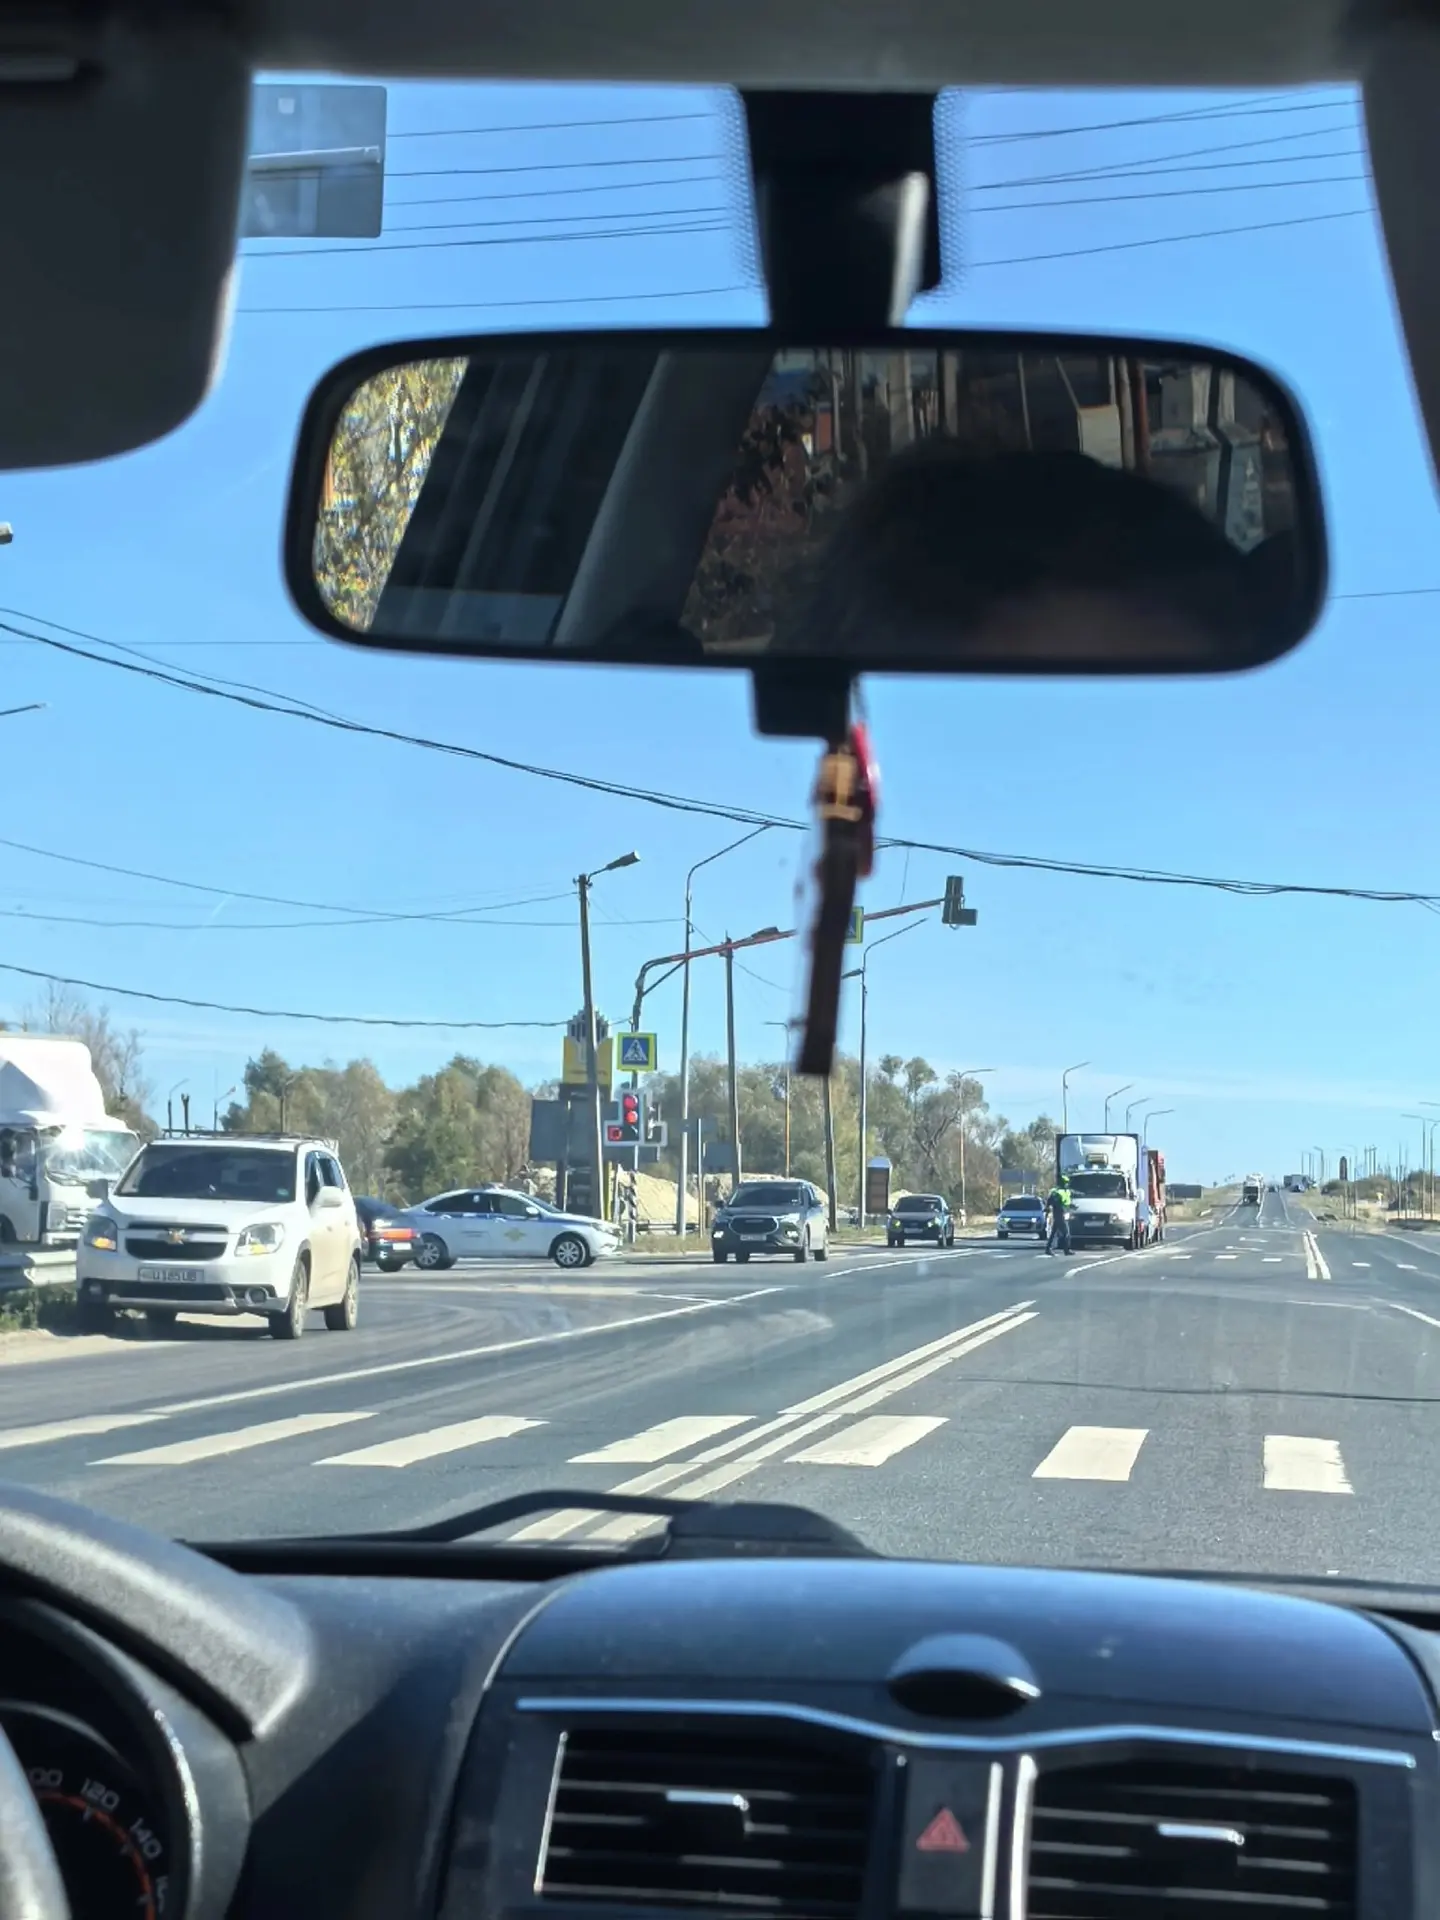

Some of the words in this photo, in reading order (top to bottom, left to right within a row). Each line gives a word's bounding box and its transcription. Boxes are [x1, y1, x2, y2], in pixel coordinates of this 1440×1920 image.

[27, 1766, 63, 1787] 00
[80, 1777, 120, 1812] 120
[130, 1817, 163, 1860] 140
